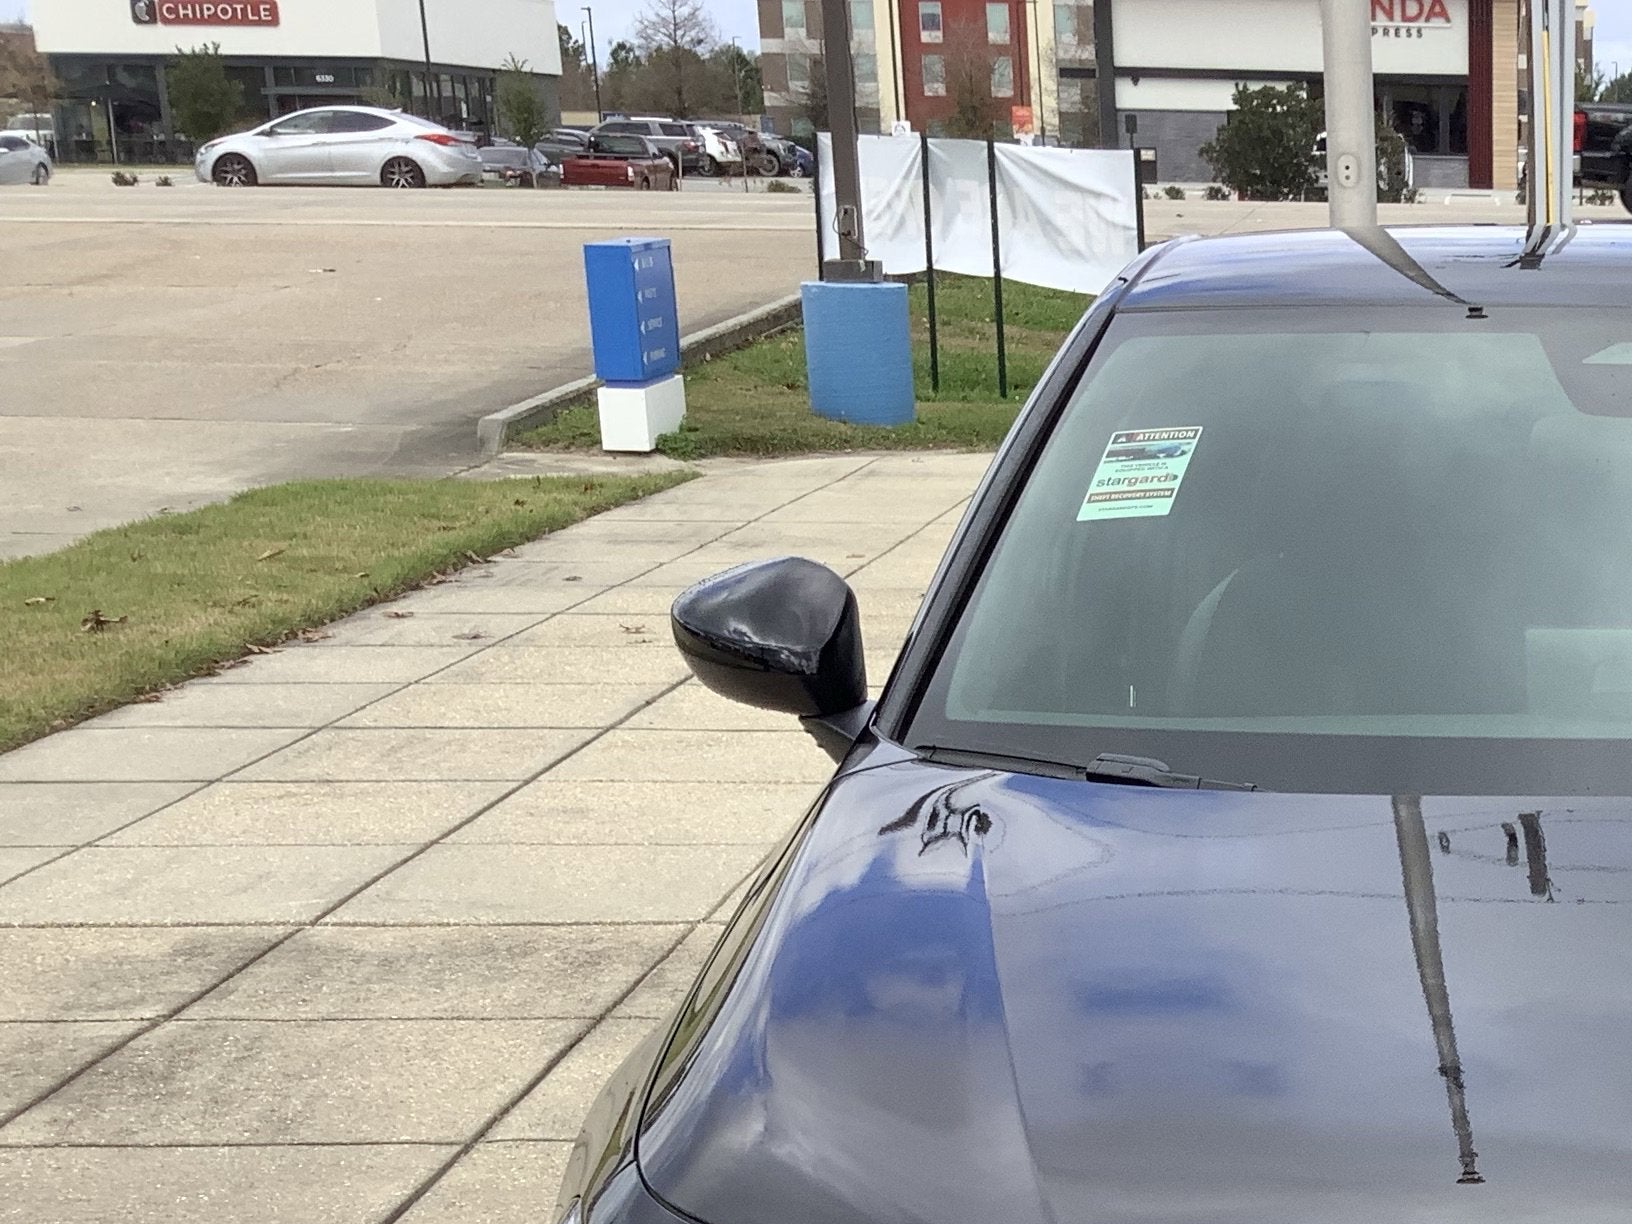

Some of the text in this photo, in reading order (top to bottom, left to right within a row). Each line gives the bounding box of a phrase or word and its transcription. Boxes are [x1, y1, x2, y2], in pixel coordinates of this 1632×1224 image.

[162, 3, 272, 21] CHIPOTLE
[1371, 0, 1451, 23] NDA
[1371, 27, 1423, 38] PRESS
[1136, 430, 1195, 441] ATTENTION
[1096, 473, 1170, 487] stargard
[1111, 491, 1145, 500] RECOVERY
